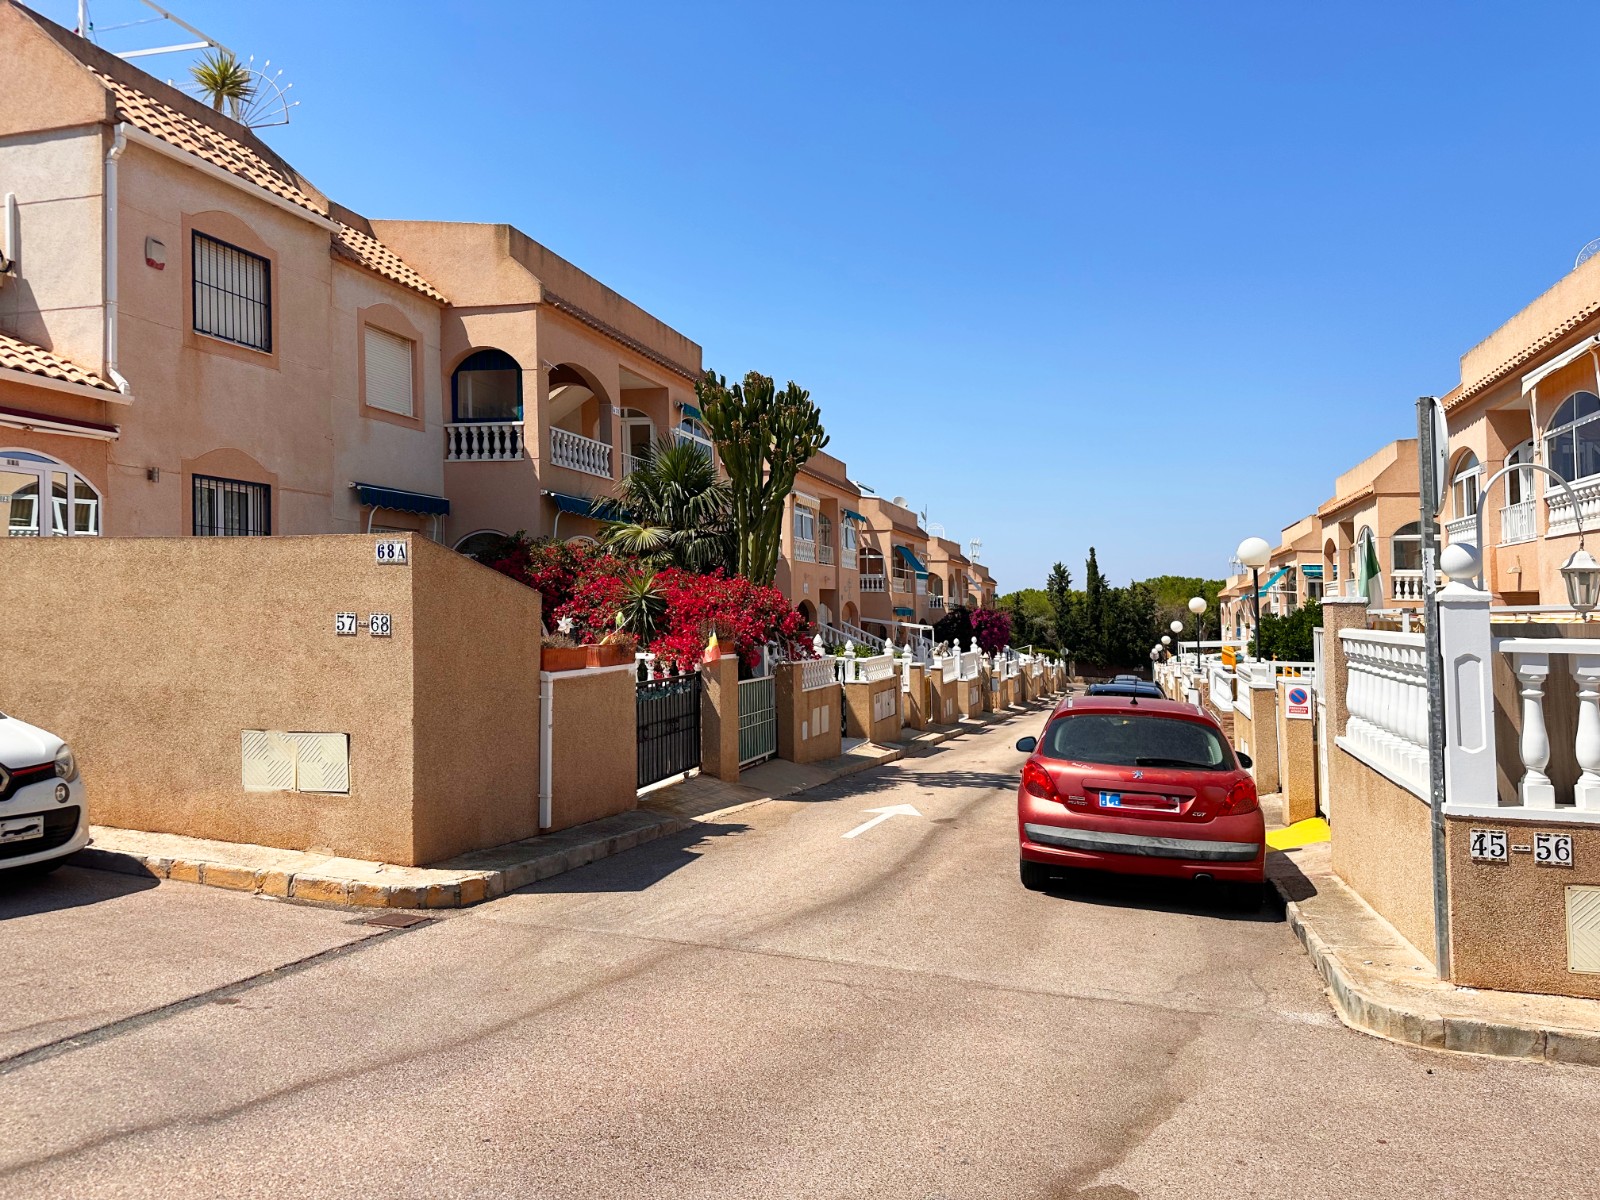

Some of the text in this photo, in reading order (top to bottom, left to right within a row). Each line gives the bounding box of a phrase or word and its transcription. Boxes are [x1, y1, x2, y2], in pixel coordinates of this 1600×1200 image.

[377, 543, 406, 559] 68A
[336, 614, 355, 631] 57
[370, 615, 389, 632] 68
[1471, 833, 1505, 857] 45
[1536, 836, 1570, 861] 56
